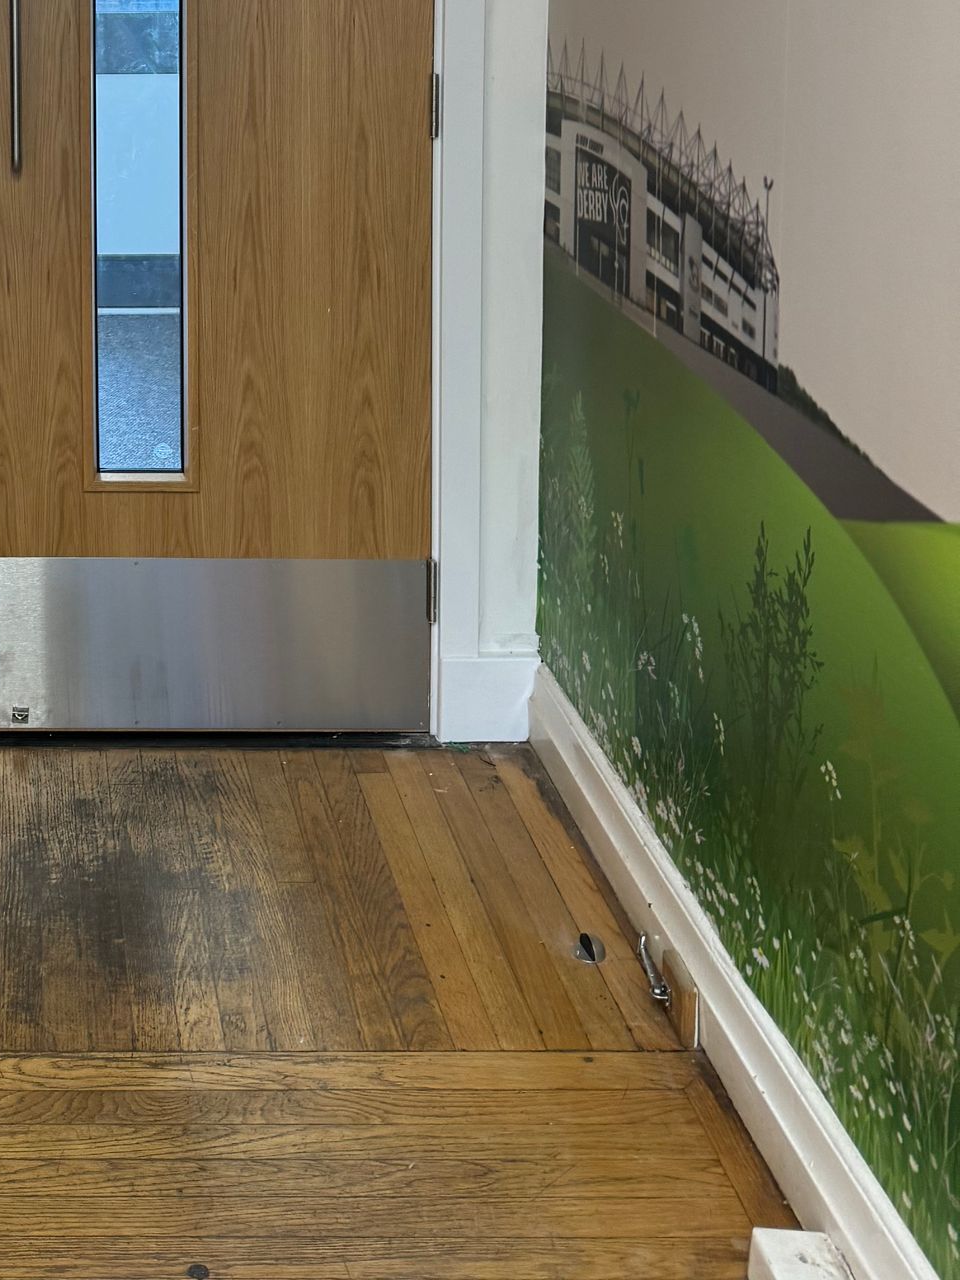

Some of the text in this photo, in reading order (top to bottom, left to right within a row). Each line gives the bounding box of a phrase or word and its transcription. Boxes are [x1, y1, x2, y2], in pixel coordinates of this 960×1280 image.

[577, 161, 609, 190] WE ARE
[577, 187, 609, 224] DERBY
